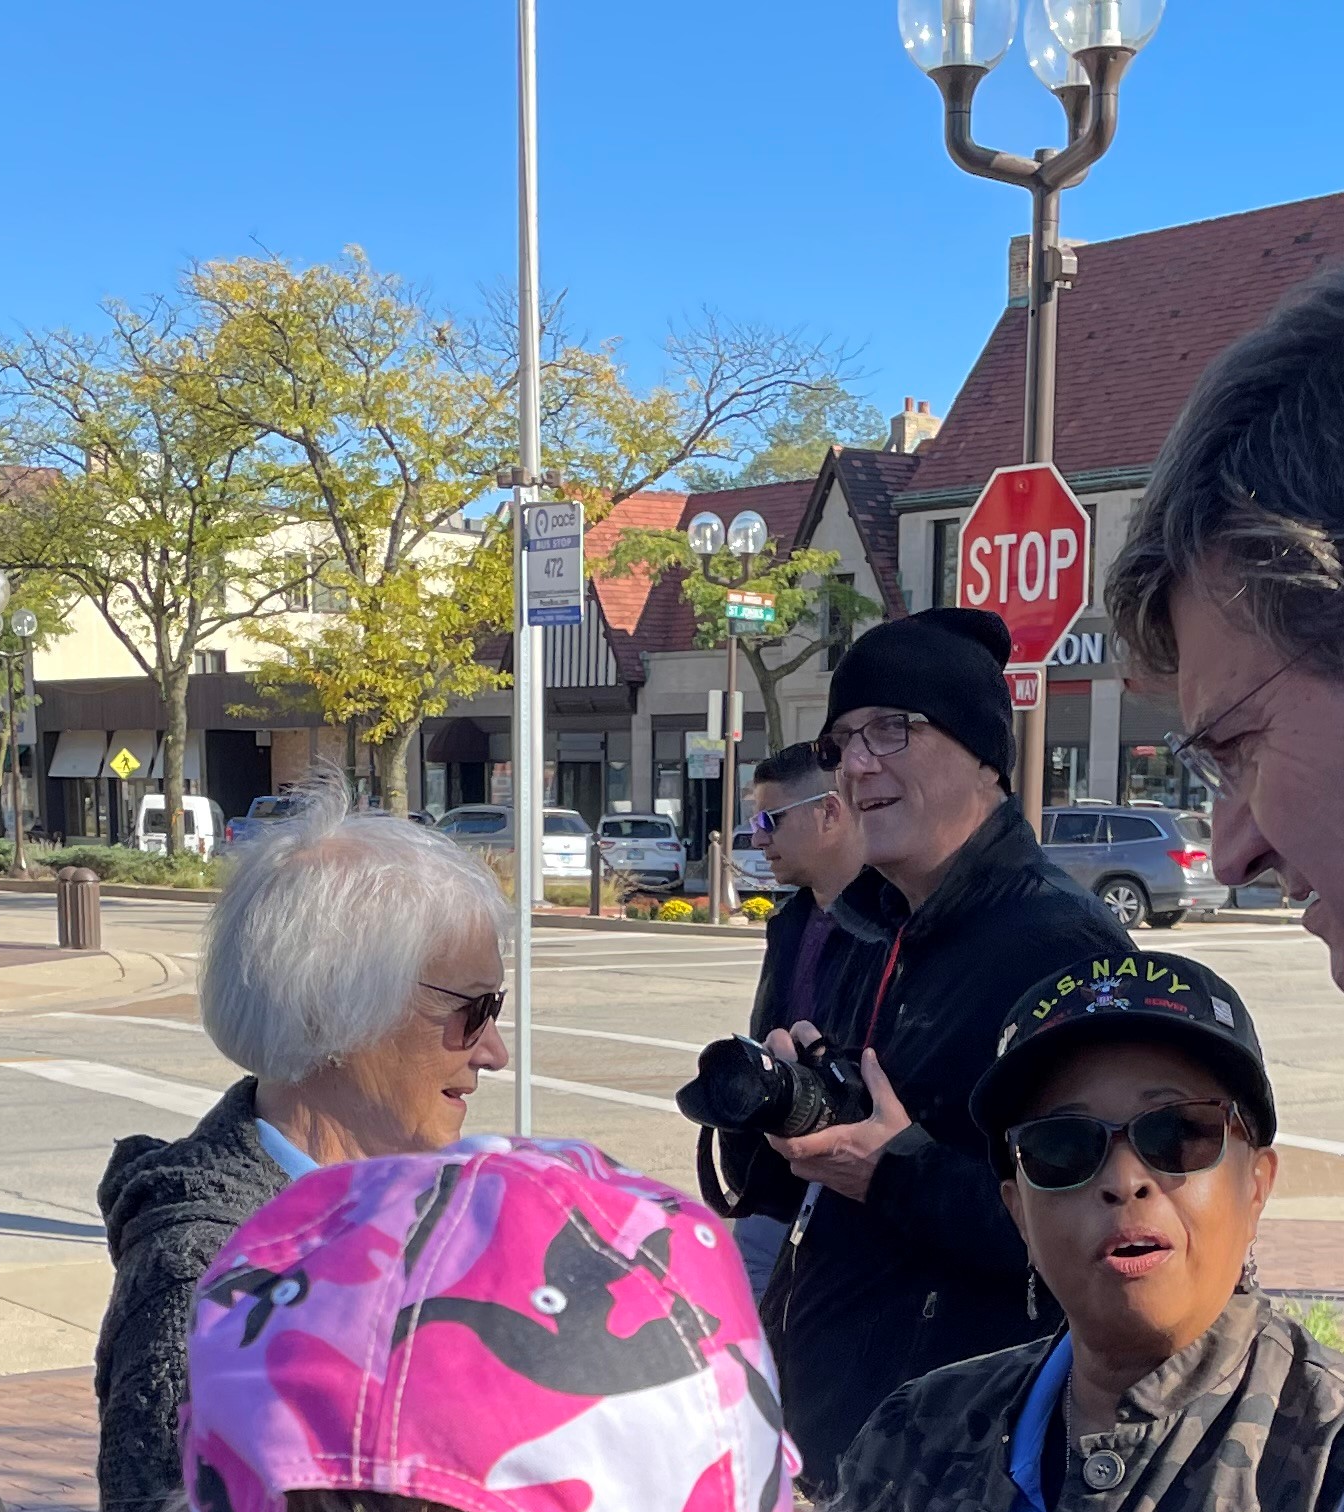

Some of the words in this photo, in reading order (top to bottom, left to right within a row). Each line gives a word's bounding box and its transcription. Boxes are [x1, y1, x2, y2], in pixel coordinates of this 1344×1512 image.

[551, 512, 576, 531] pace
[552, 538, 572, 548] STOP
[544, 557, 564, 578] 472
[966, 528, 1078, 606] STOP
[1046, 632, 1104, 666] ON
[1015, 679, 1038, 701] WAY
[1032, 975, 1084, 1019] U.S.
[1092, 957, 1191, 994] NAVY
